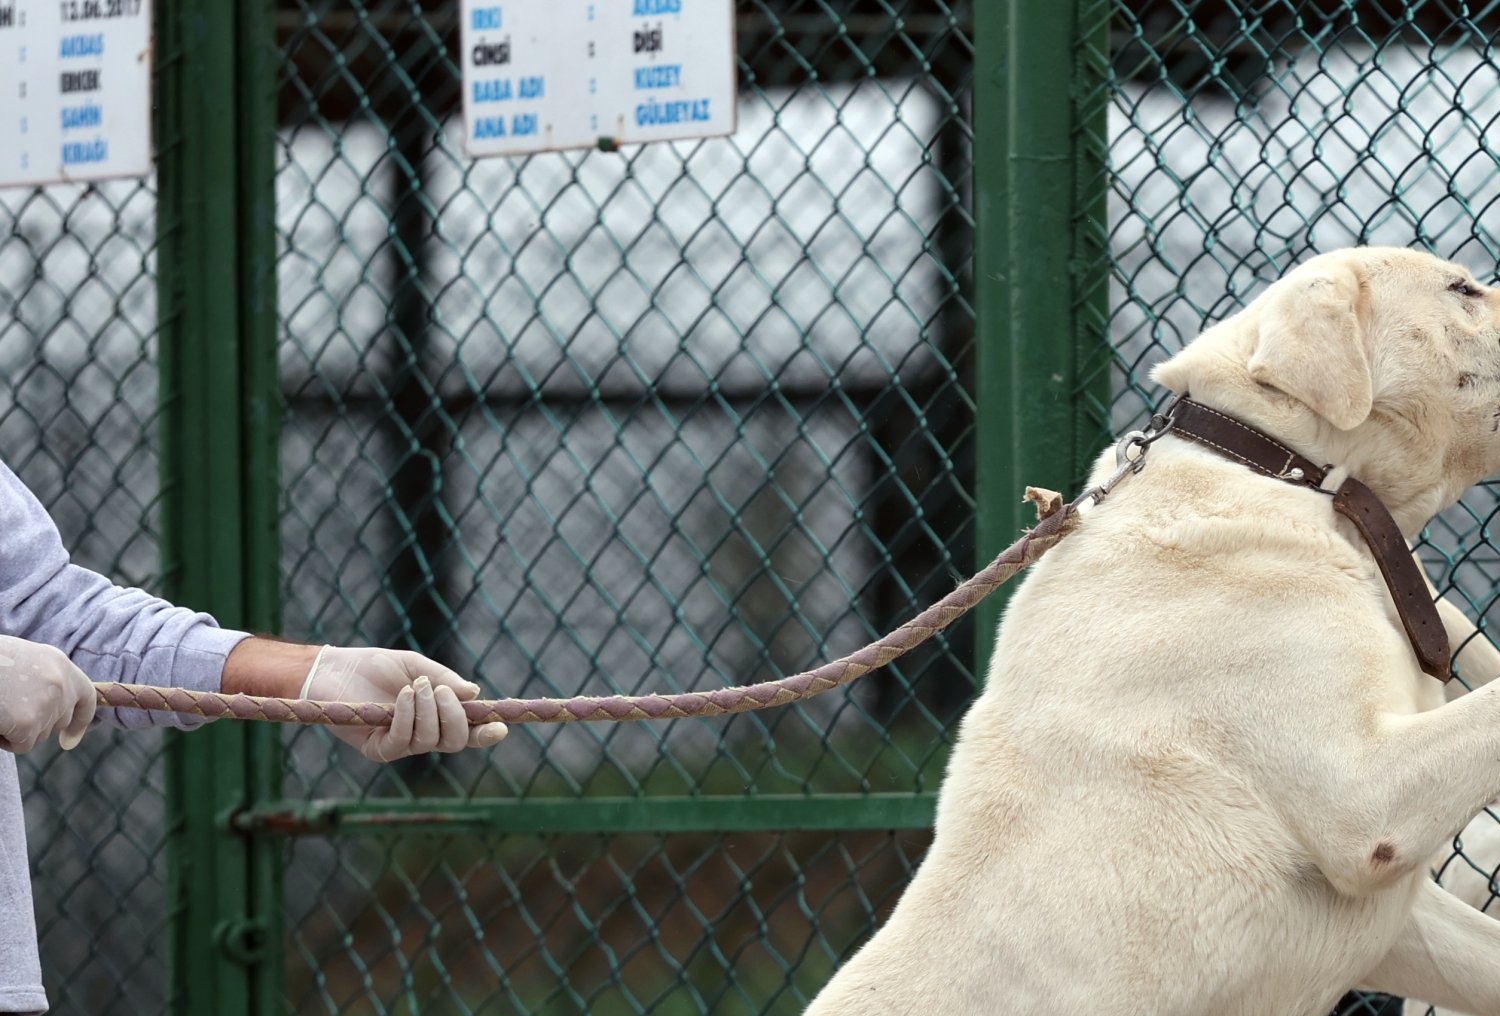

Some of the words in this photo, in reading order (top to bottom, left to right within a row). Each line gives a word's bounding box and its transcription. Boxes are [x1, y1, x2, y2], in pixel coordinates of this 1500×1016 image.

[470, 7, 502, 30] IRKI
[471, 35, 511, 67] CİNSİ
[633, 22, 662, 59] DİŞİ
[473, 79, 512, 103] BABA
[518, 76, 545, 99] ADI
[634, 65, 681, 89] KUZEY
[473, 116, 507, 140] ANA
[511, 113, 538, 137] ADI
[635, 97, 711, 127] GÜLBEYAZ
